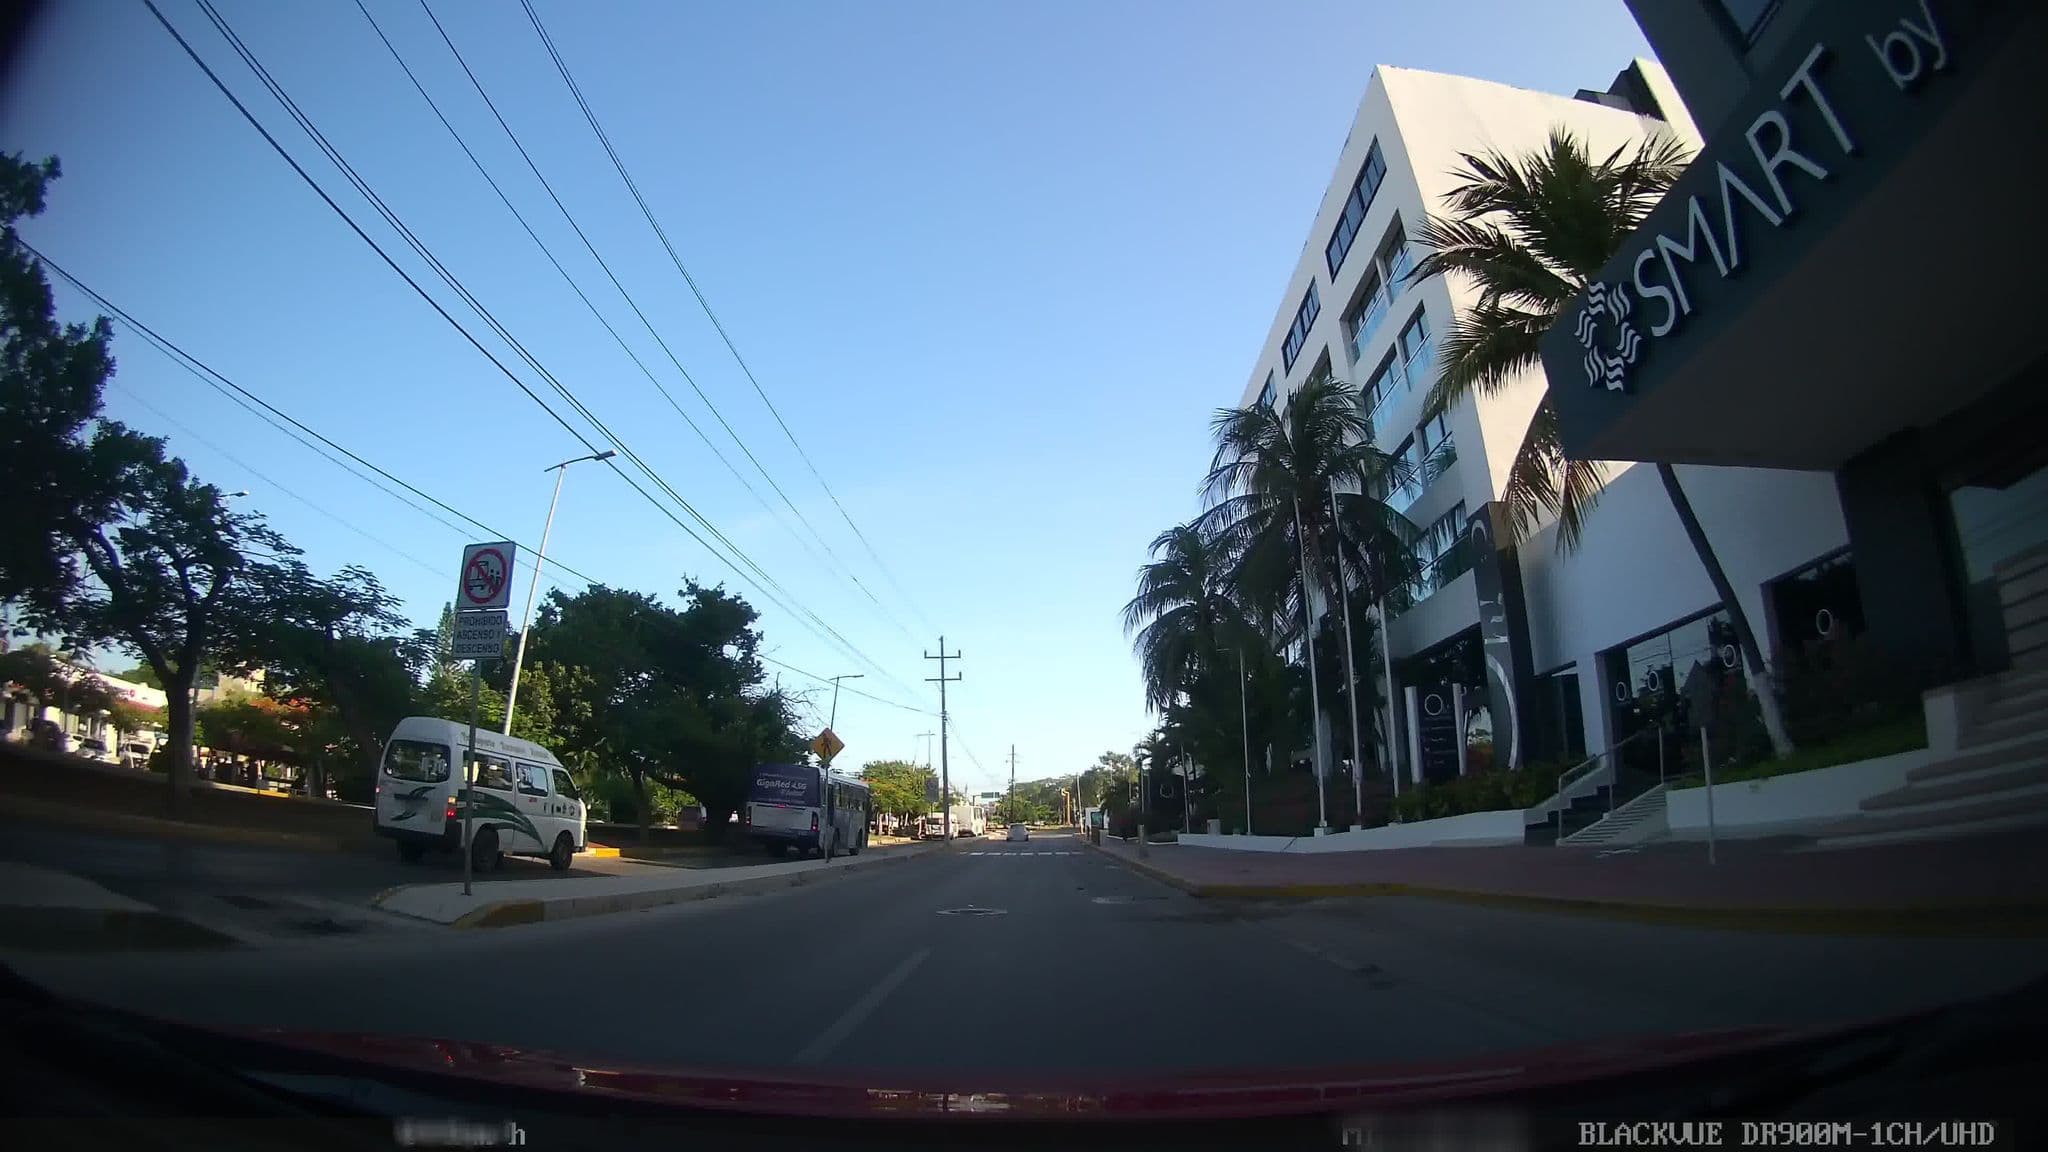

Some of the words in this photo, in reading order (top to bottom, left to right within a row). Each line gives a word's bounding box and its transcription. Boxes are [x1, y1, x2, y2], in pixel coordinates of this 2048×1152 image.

[1634, 43, 1855, 337] SMART
[1865, 0, 1947, 90] by
[459, 616, 502, 626] PROHIBIDO
[457, 629, 494, 640] ASCENSO
[456, 643, 499, 653] DESCENSO
